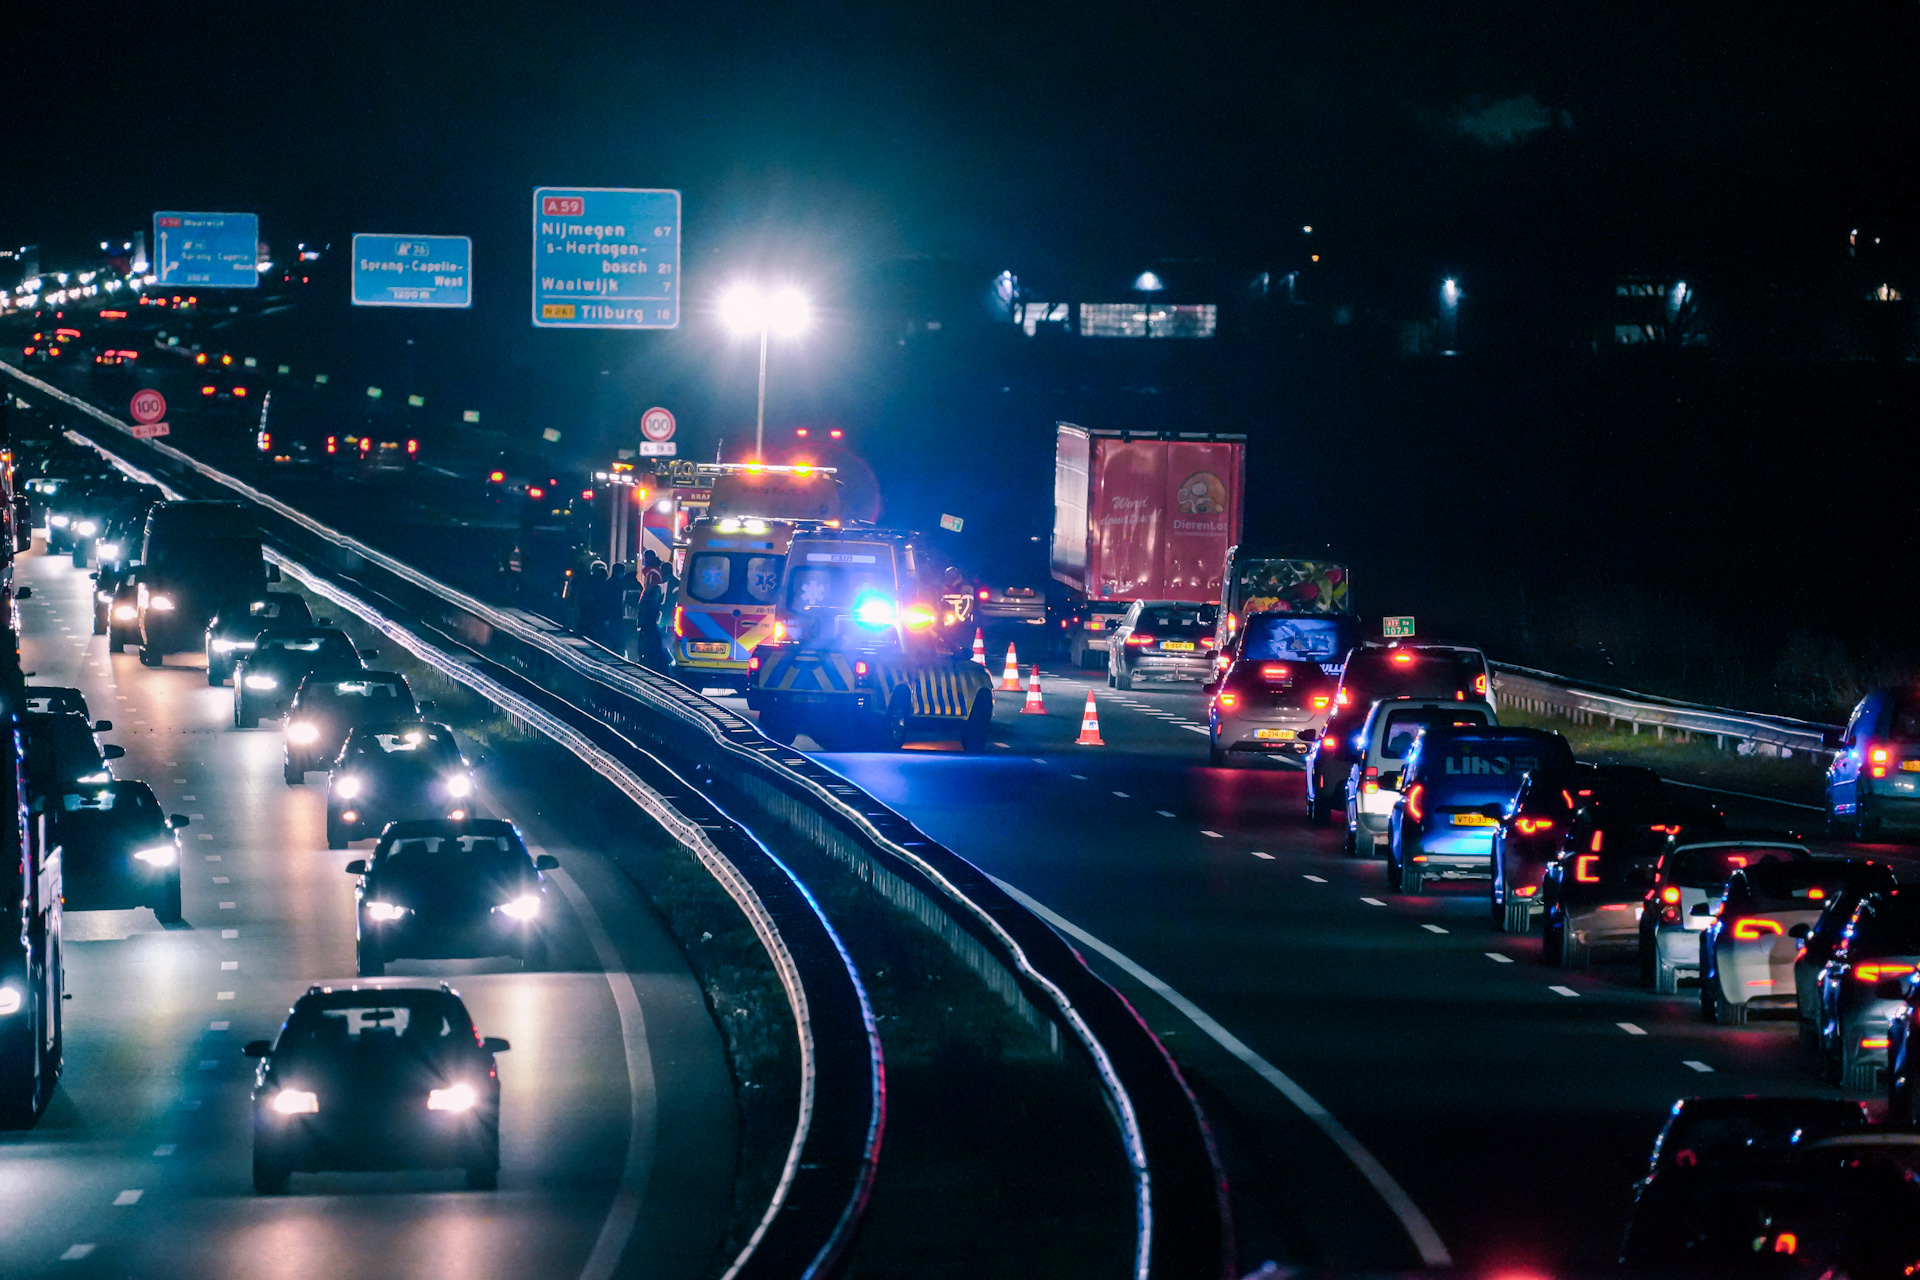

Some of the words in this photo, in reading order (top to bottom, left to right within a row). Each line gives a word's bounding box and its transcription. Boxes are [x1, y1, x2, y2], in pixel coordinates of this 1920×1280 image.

[542, 222, 625, 240] Nijmegen
[653, 226, 672, 237] 67
[602, 260, 647, 274] bosch
[657, 263, 671, 274] 21
[434, 275, 463, 287] West
[542, 277, 619, 295] Waalwijk
[662, 281, 671, 292] 7
[581, 304, 644, 323] Tilburg
[137, 400, 159, 413] 100
[648, 418, 669, 431] 100
[1173, 519, 1228, 531] DierenLot
